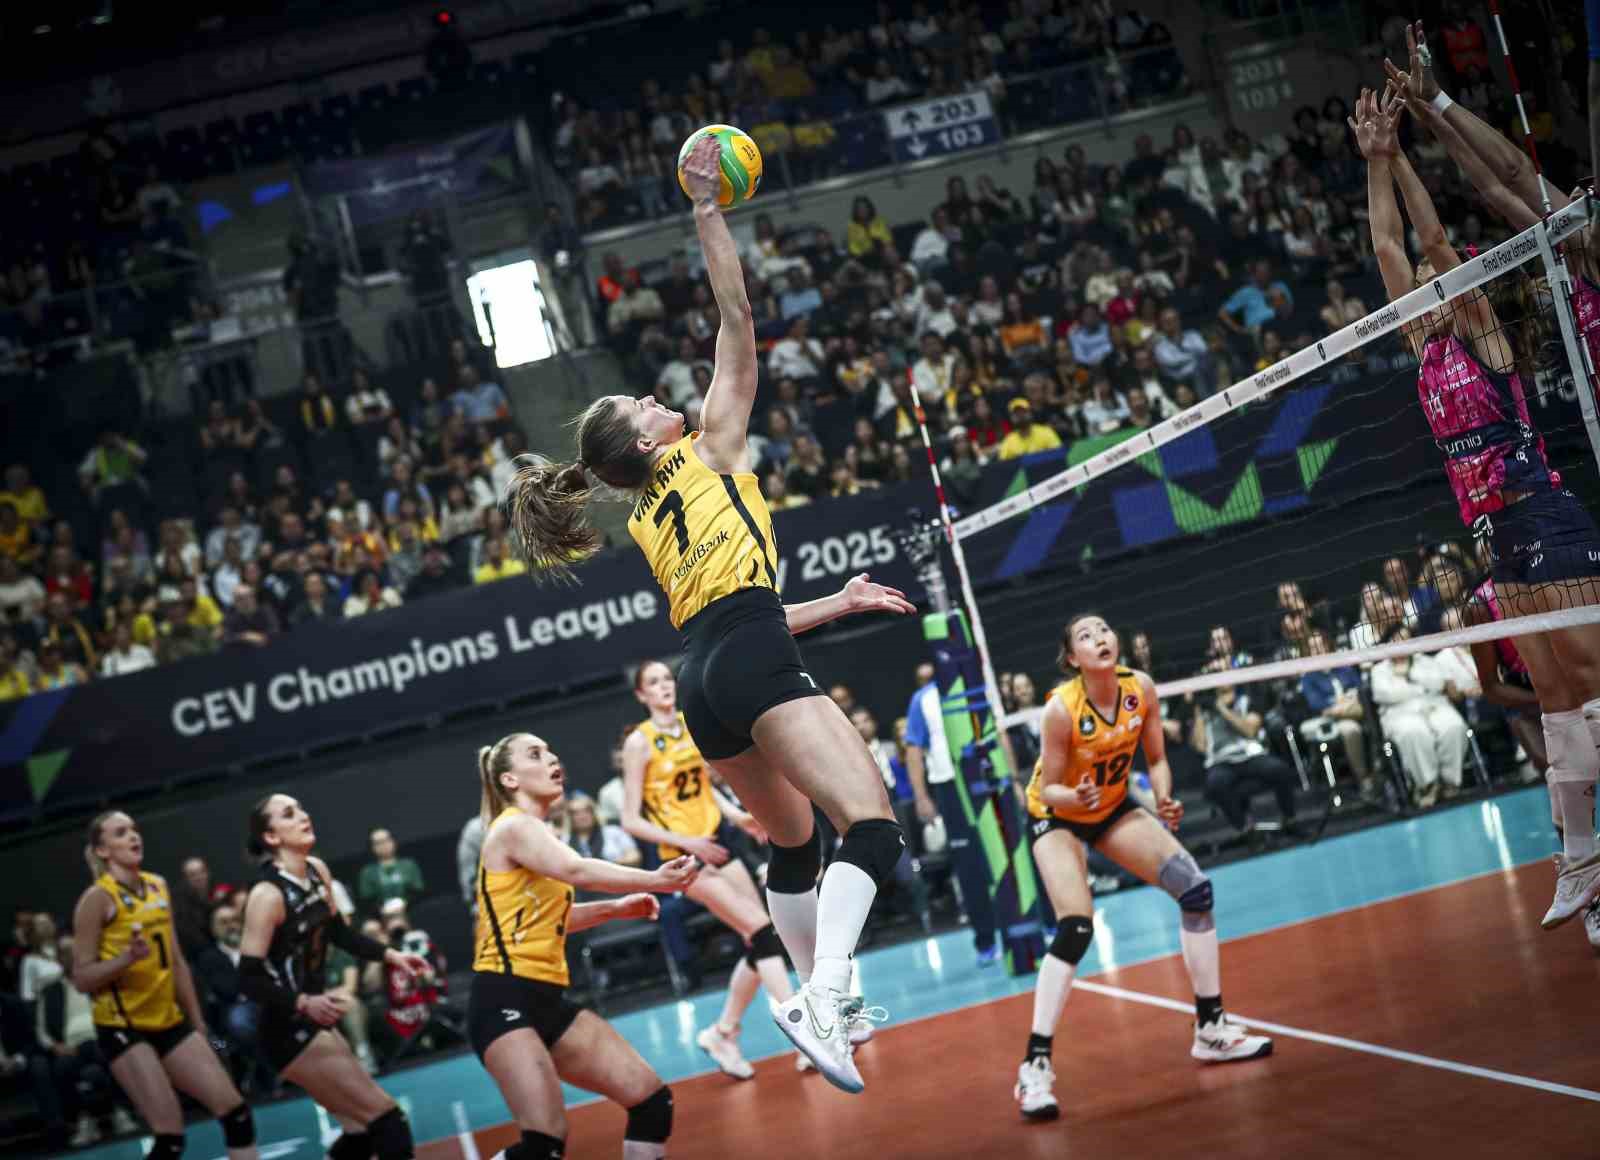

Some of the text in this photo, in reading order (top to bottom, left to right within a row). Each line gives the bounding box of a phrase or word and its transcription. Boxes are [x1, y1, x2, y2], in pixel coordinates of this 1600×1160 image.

[931, 98, 977, 123] 203
[938, 123, 984, 151] 103
[1482, 253, 1500, 274] Final
[1497, 248, 1513, 264] Four
[634, 483, 660, 522] VAN
[652, 489, 691, 557] 7
[796, 524, 897, 580] 2025
[171, 590, 658, 737] CEV Champions League
[674, 766, 702, 802] 23
[1092, 751, 1131, 787] 12
[151, 932, 169, 971] 1
